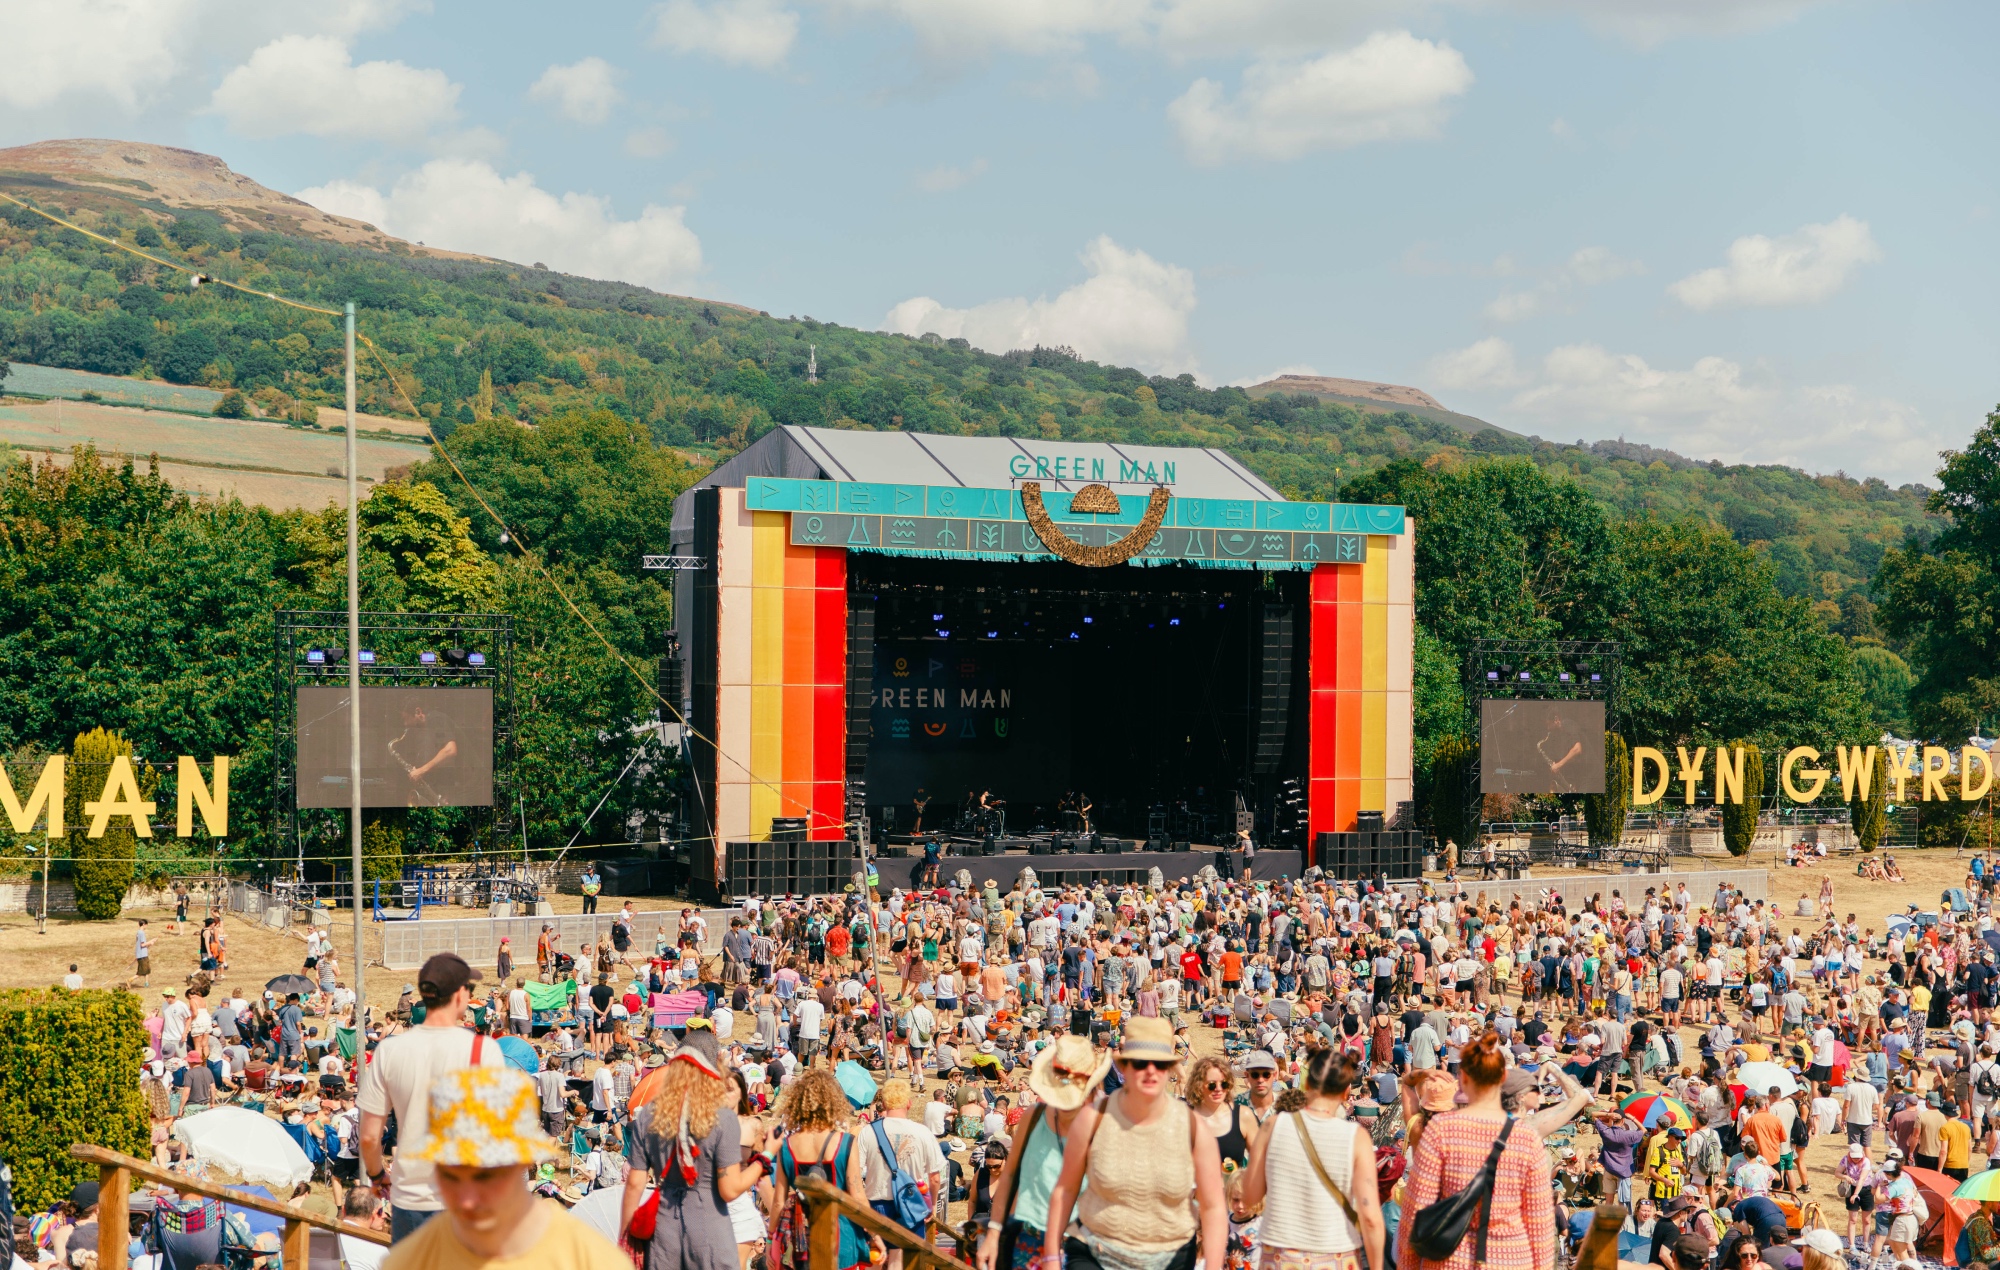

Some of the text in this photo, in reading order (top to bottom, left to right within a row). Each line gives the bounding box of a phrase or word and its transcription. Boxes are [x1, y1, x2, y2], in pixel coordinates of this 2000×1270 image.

[1009, 455, 1176, 483] GREEN MAN
[960, 688, 1011, 708] MAN
[0, 754, 229, 838] MAN
[1633, 745, 1993, 805] DYN GWYRD
